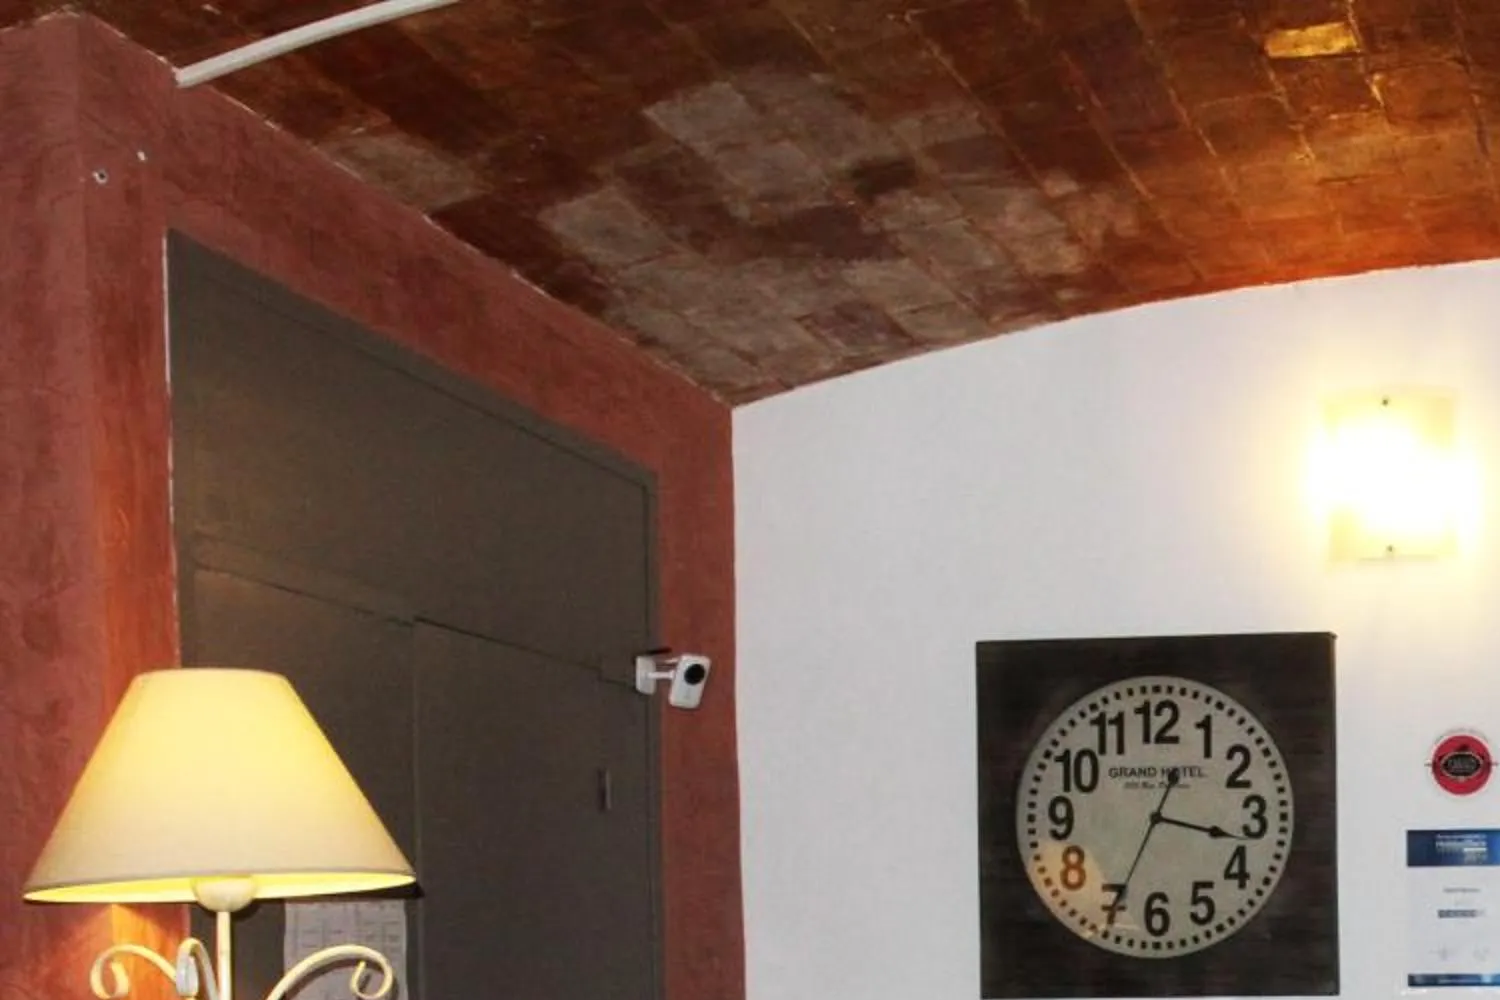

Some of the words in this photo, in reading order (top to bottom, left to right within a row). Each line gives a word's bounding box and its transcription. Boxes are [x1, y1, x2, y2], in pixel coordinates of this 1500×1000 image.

[1090, 711, 1125, 756] 11
[1134, 699, 1180, 745] 12
[1195, 715, 1213, 759] 1
[1054, 748, 1099, 793] 10
[1108, 767, 1157, 778] GRAND
[1161, 766, 1207, 778] HTEL
[1225, 744, 1252, 789] 2
[1048, 796, 1074, 841] 9
[1242, 795, 1269, 840] 3
[1060, 845, 1087, 890] 8
[1223, 845, 1250, 890] 4
[1101, 883, 1127, 926] 7
[1144, 891, 1170, 937] 6
[1190, 881, 1216, 926] 5
